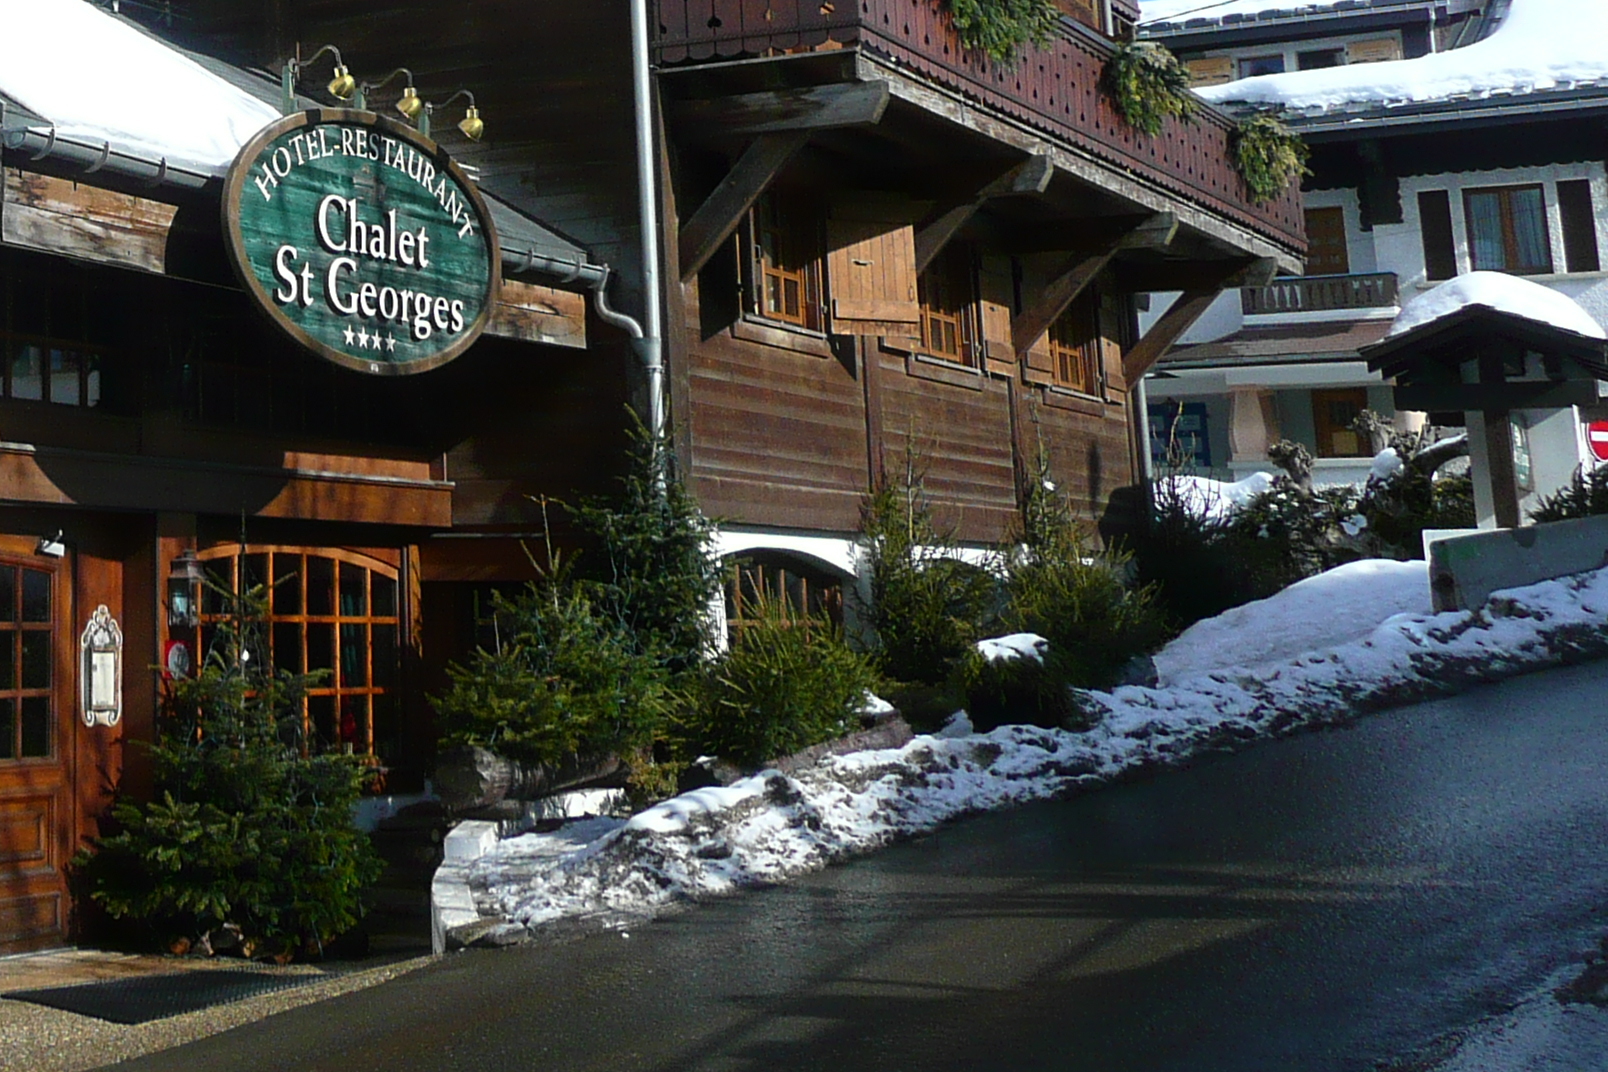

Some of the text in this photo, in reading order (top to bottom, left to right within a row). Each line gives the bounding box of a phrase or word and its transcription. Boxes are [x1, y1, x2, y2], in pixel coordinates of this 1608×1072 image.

[254, 128, 473, 240] HOTEL-RESTAURANT
[317, 193, 430, 269] Chalet
[275, 244, 465, 340] St Georges
